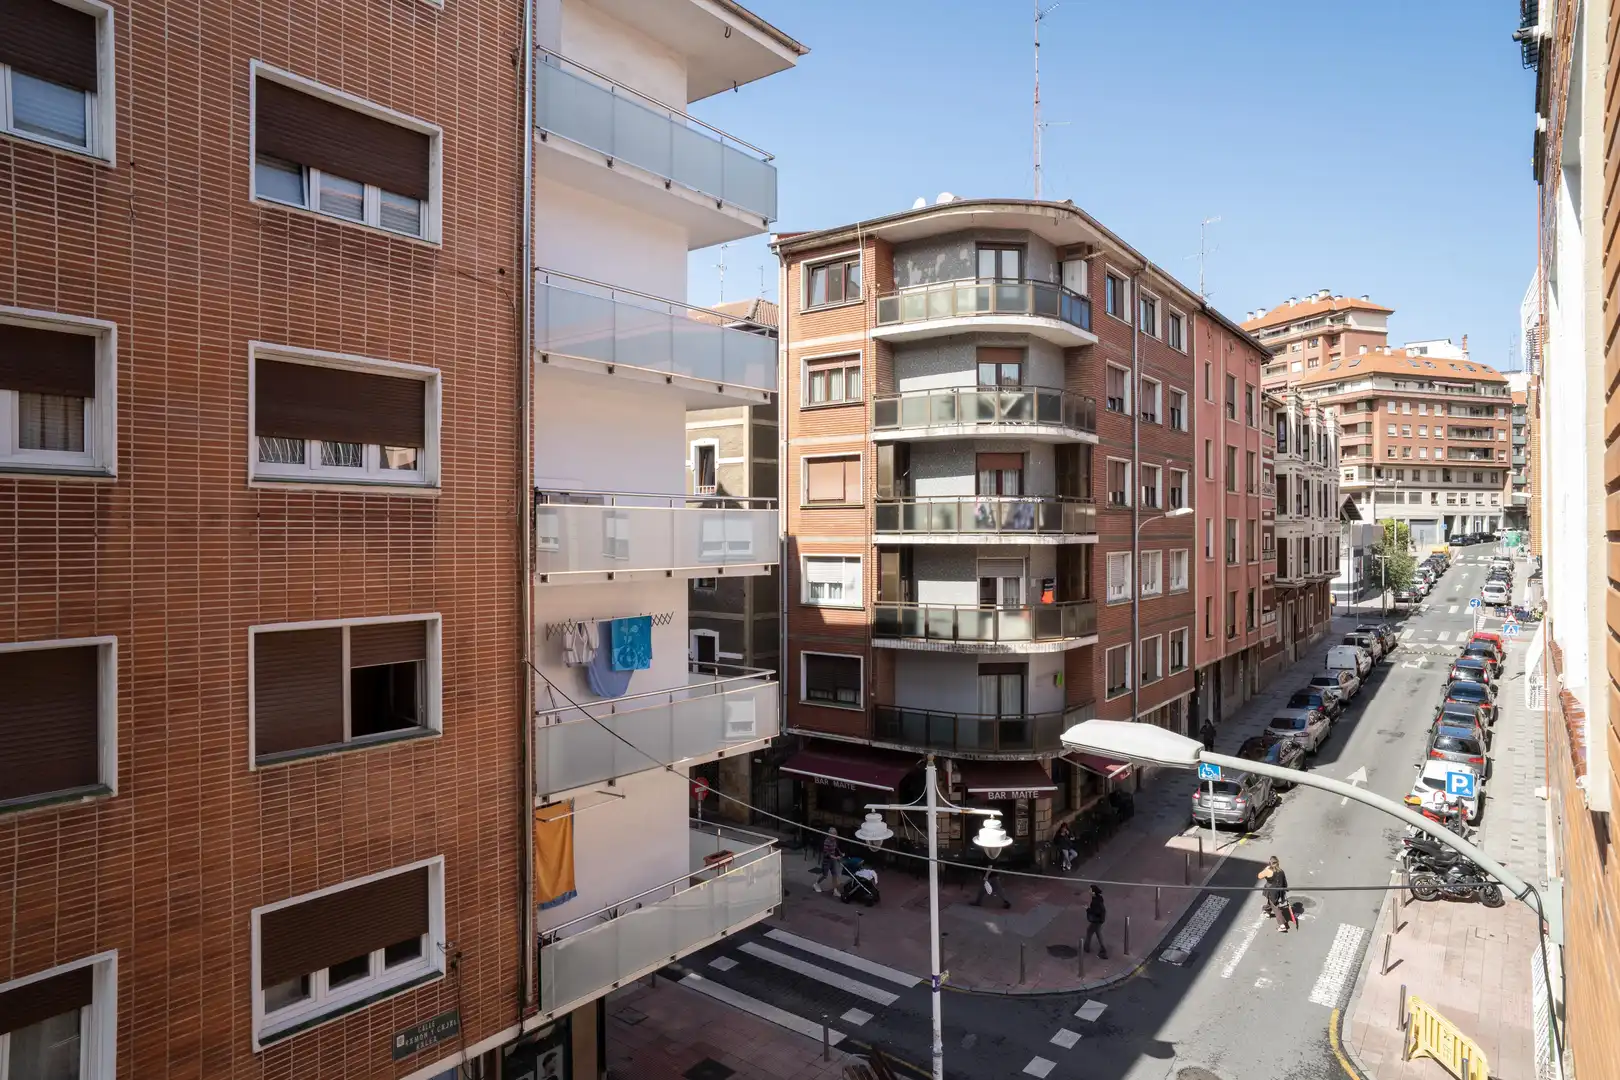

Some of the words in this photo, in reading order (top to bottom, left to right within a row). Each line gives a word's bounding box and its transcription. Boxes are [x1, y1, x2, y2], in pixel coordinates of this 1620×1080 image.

[814, 776, 829, 786] BAR
[833, 779, 857, 791] MAITE
[1451, 774, 1468, 792] P
[988, 791, 1006, 800] BAR
[1011, 790, 1039, 799] MAITE
[417, 1020, 435, 1033] CALLE
